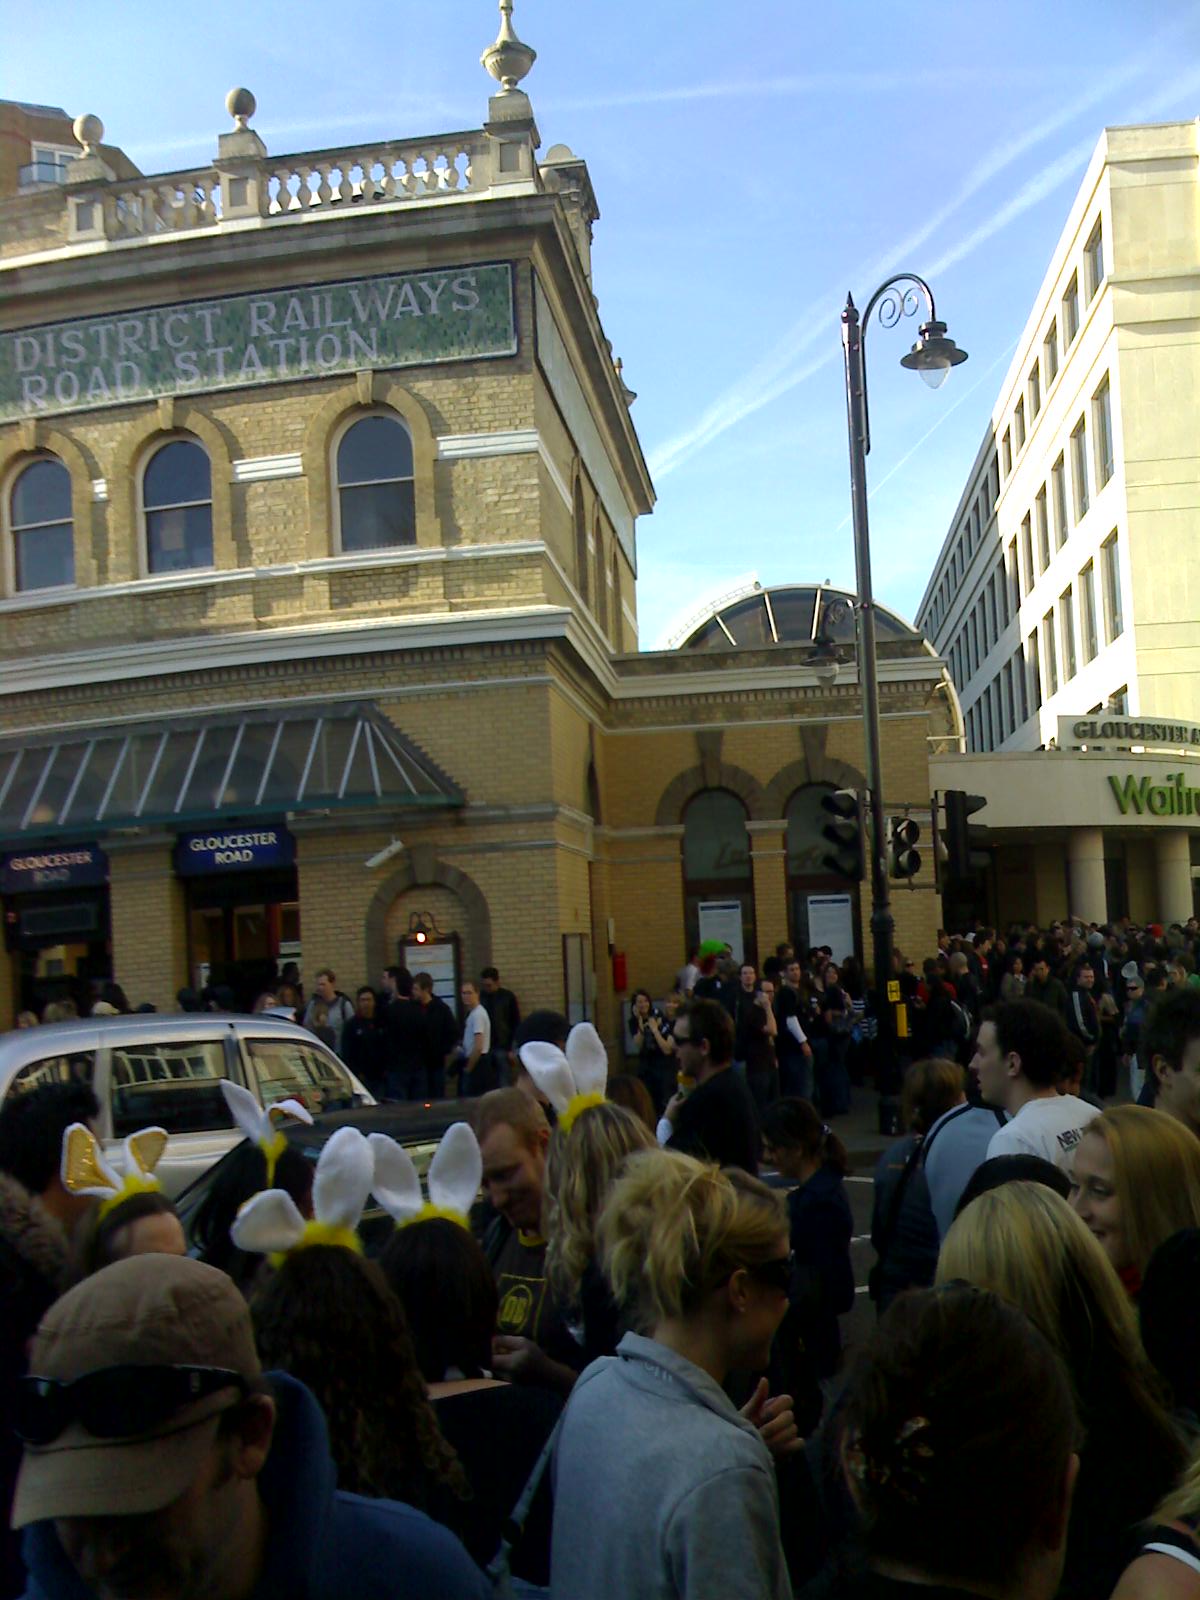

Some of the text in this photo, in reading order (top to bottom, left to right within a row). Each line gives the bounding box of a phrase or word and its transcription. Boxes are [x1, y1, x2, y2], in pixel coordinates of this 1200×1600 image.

[14, 276, 481, 372] DISTRICT RAILWAYS
[21, 327, 378, 411] ROAD STATION
[1073, 721, 1188, 744] GLOUCESTER
[1107, 772, 1200, 816] Waitr
[190, 832, 277, 852] GLOUCESTER
[10, 851, 92, 871] GLOUCESTER
[215, 849, 253, 864] ROAD
